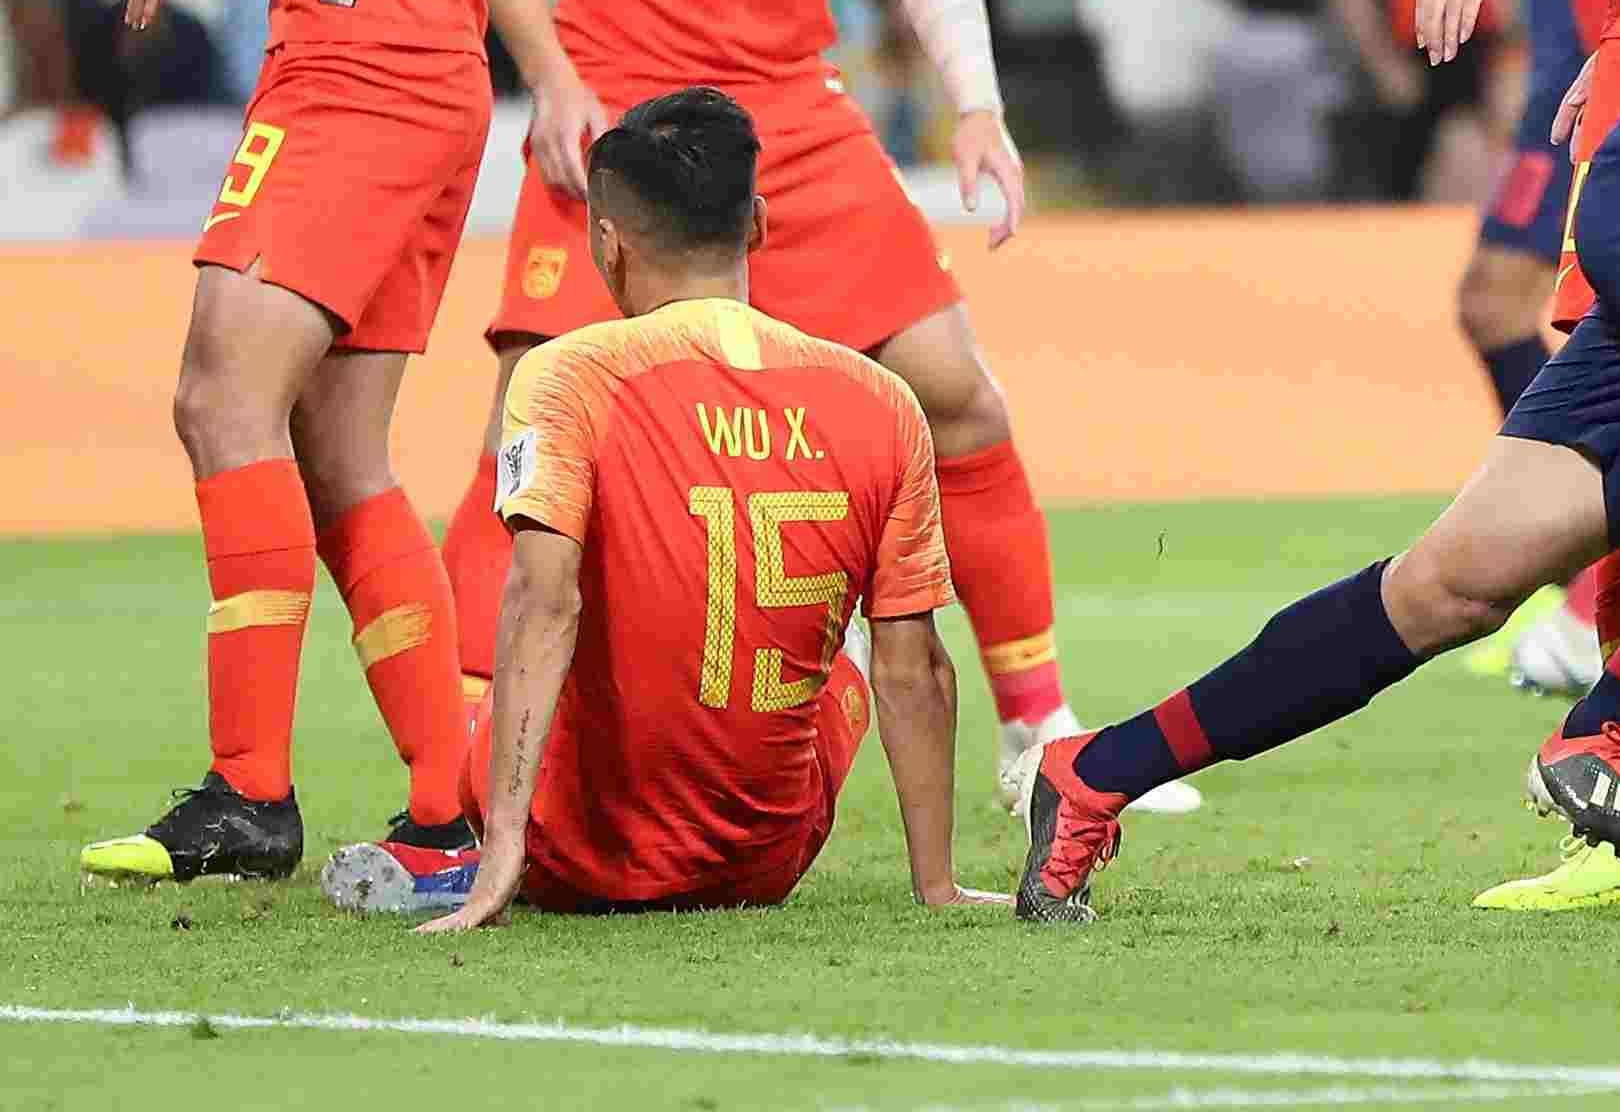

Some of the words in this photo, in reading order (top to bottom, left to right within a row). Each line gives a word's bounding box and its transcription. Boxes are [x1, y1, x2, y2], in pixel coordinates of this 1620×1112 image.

[218, 120, 287, 207] 9
[696, 403, 772, 461] WU
[784, 407, 826, 460] X.
[688, 486, 849, 712] 15
